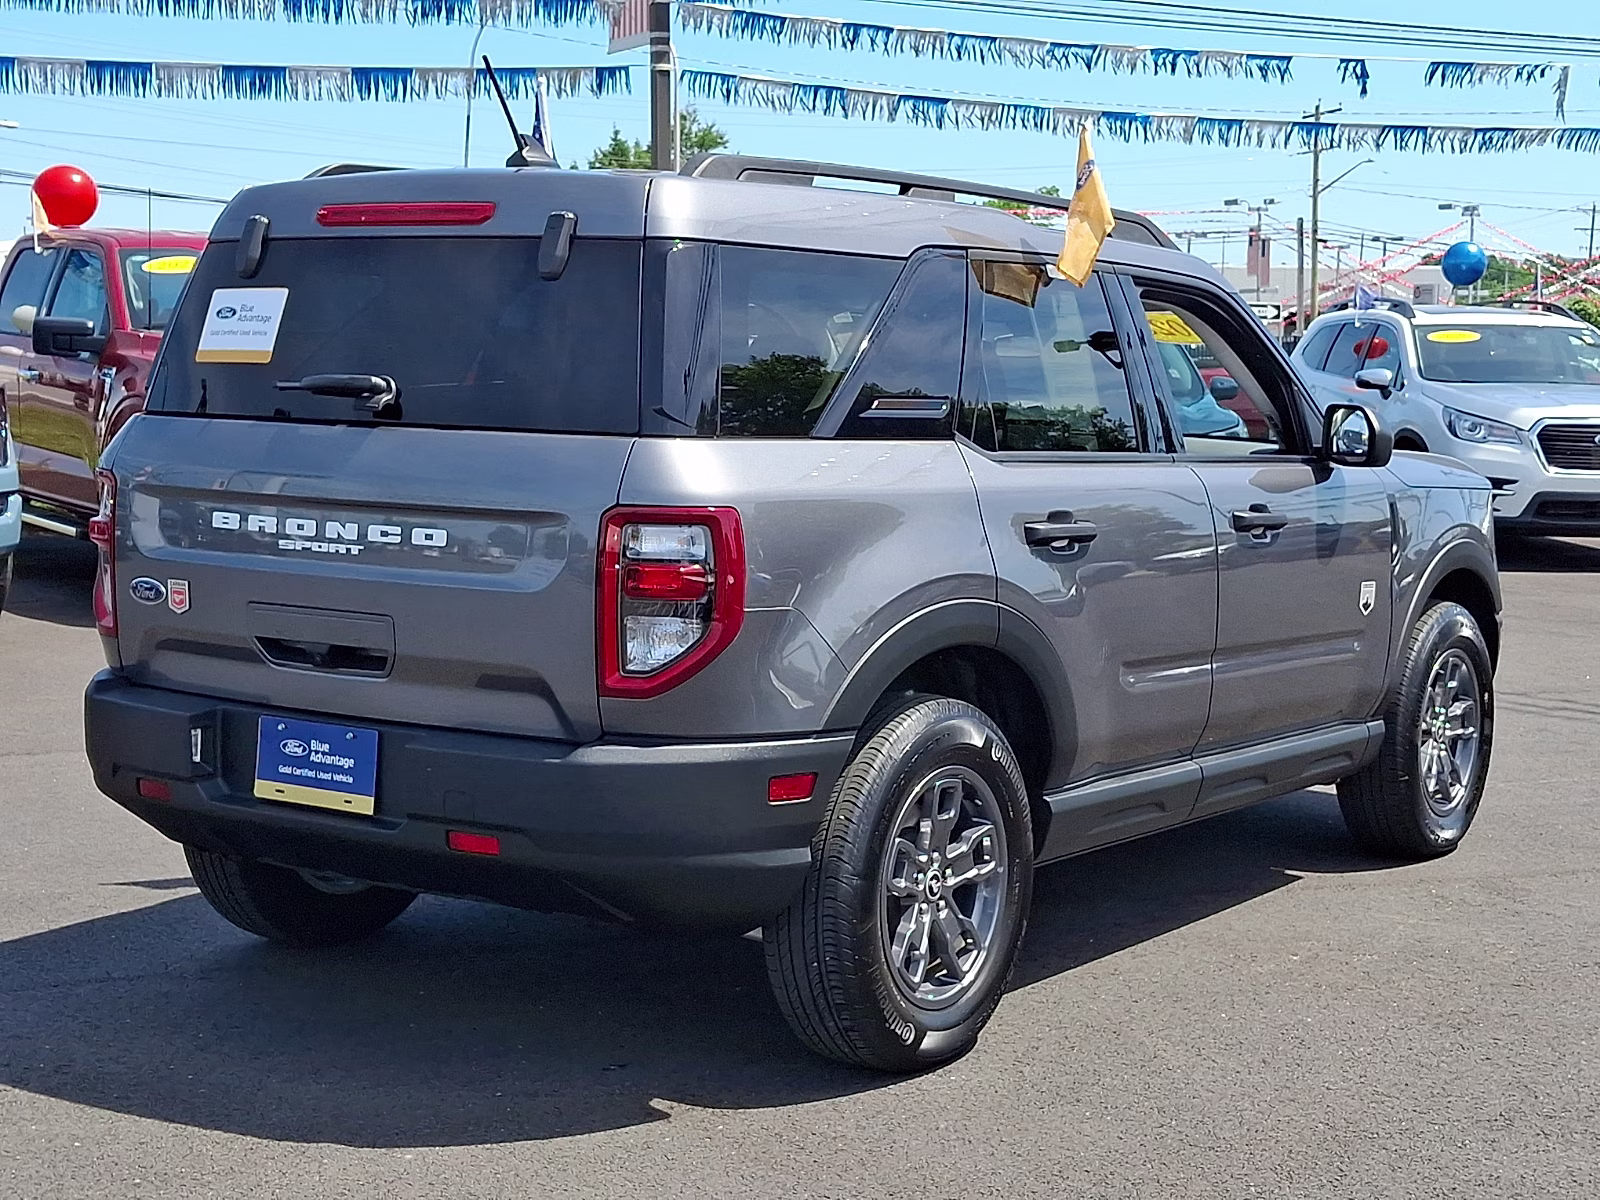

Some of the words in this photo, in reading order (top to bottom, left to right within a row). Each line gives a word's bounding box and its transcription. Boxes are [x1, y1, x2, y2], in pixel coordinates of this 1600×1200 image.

[240, 303, 255, 313] Blue
[237, 314, 272, 325] Advantage
[211, 510, 449, 548] BRONCO
[277, 538, 365, 555] SPORT
[283, 740, 307, 755] Ford
[310, 739, 330, 753] Blue
[309, 751, 355, 769] Advantage
[278, 764, 292, 774] Gold
[292, 767, 316, 779] Certified
[316, 770, 332, 781] Used
[332, 772, 354, 784] Vehicle
